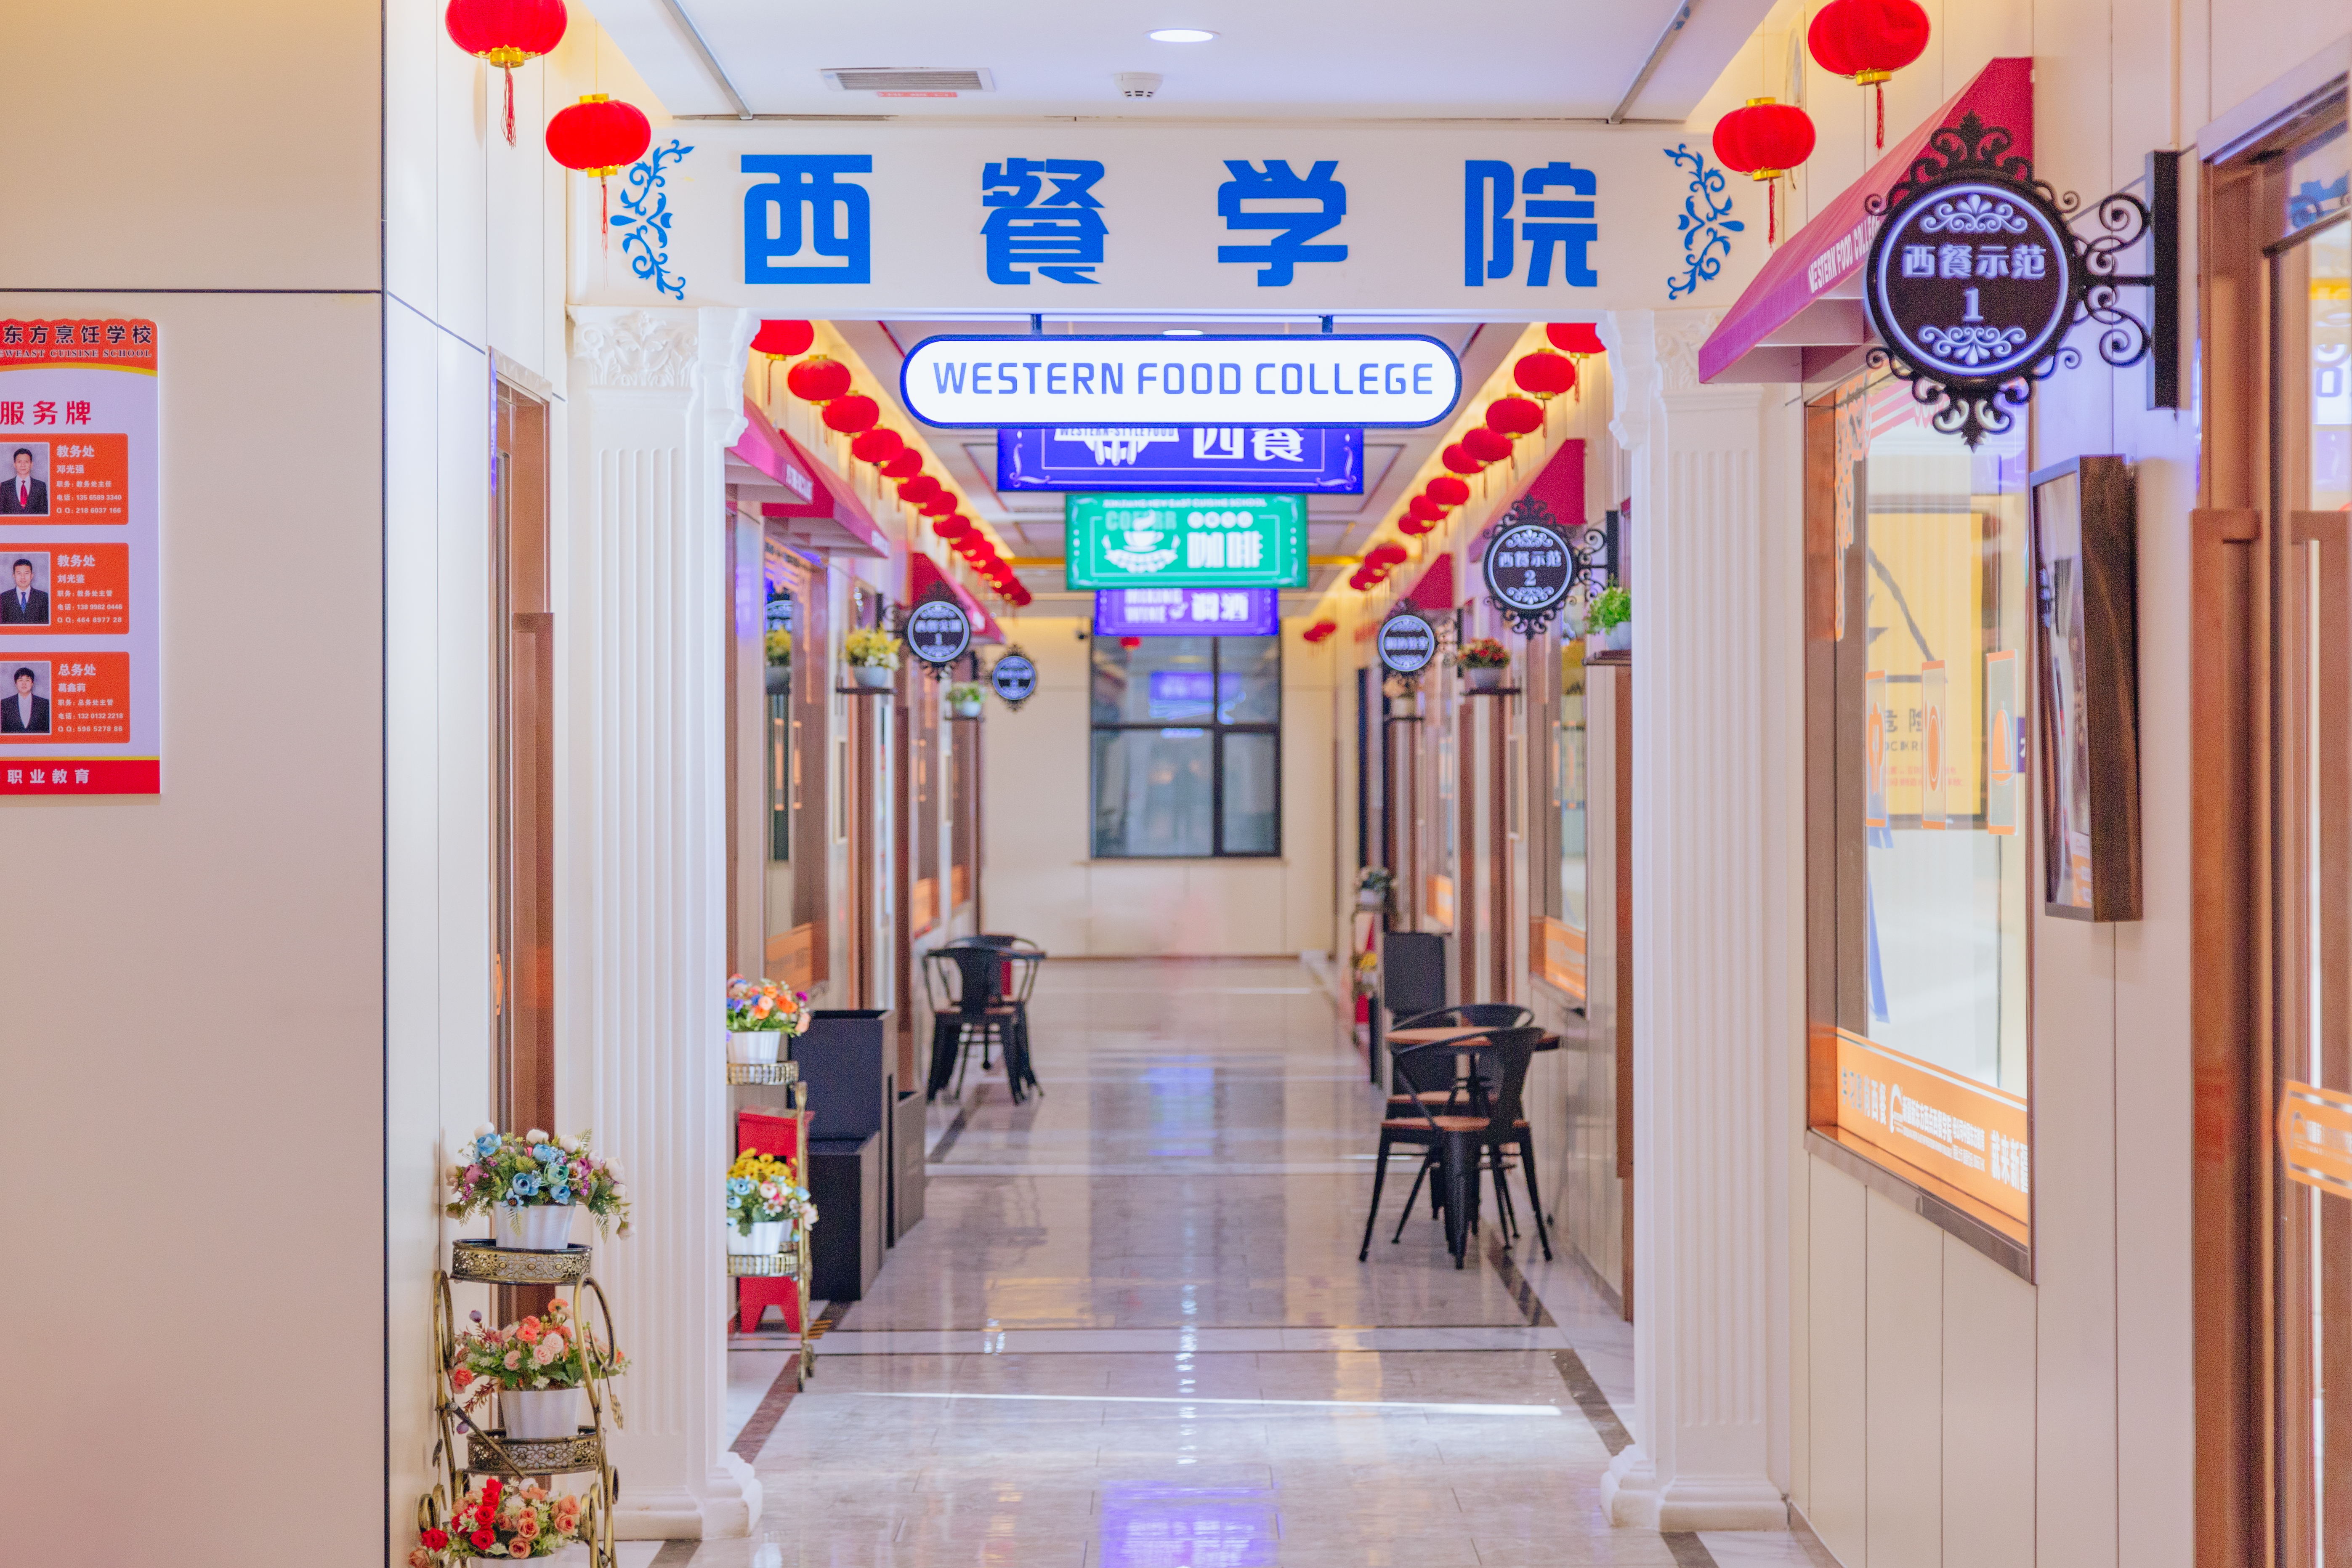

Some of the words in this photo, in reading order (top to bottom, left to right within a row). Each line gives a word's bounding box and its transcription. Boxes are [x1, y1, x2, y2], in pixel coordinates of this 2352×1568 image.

[741, 154, 1598, 287] 西餐学院
[1808, 246, 1837, 293] WESTERN
[1836, 234, 1853, 274] FOOD
[1902, 243, 2047, 279] 西餐示范
[1962, 289, 1984, 322] 1
[4, 325, 151, 344] 东方烹饪学校
[933, 362, 1124, 395] WESTERN
[1138, 362, 1241, 395] FOOD
[1256, 362, 1433, 395] COLLEGE
[0, 400, 91, 425] 服务牌
[56, 445, 95, 457] 教务处
[57, 555, 95, 567] 教务处
[1498, 550, 1562, 568] 西餐示范
[1524, 570, 1536, 586] 2
[58, 664, 96, 676] 总务处
[7, 768, 90, 784] 职业教育
